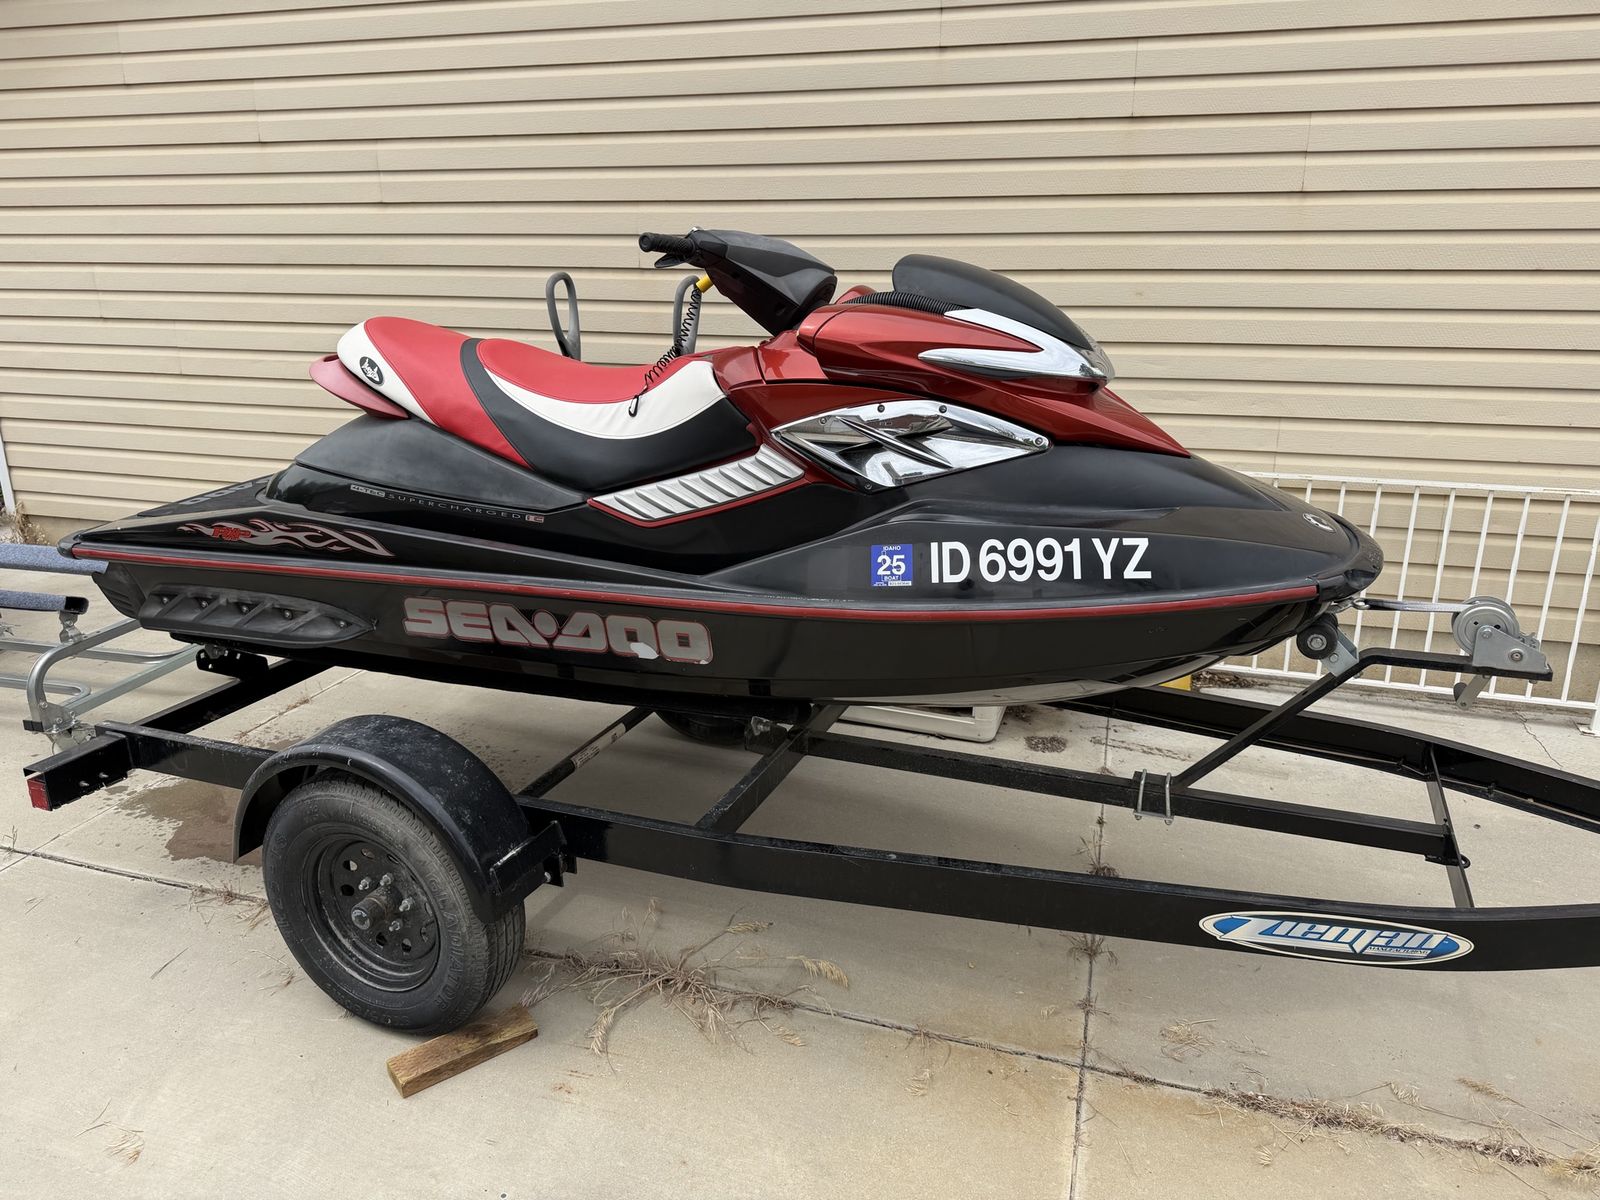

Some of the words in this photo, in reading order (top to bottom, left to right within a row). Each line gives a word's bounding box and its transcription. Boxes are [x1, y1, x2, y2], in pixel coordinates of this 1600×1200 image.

[388, 493, 522, 519] SUPERCHARGED
[877, 554, 906, 575] 25
[930, 541, 971, 583] ID
[979, 537, 1082, 583] 6991
[1091, 537, 1152, 580] YZ
[1368, 945, 1429, 956] MANUFACTURING
